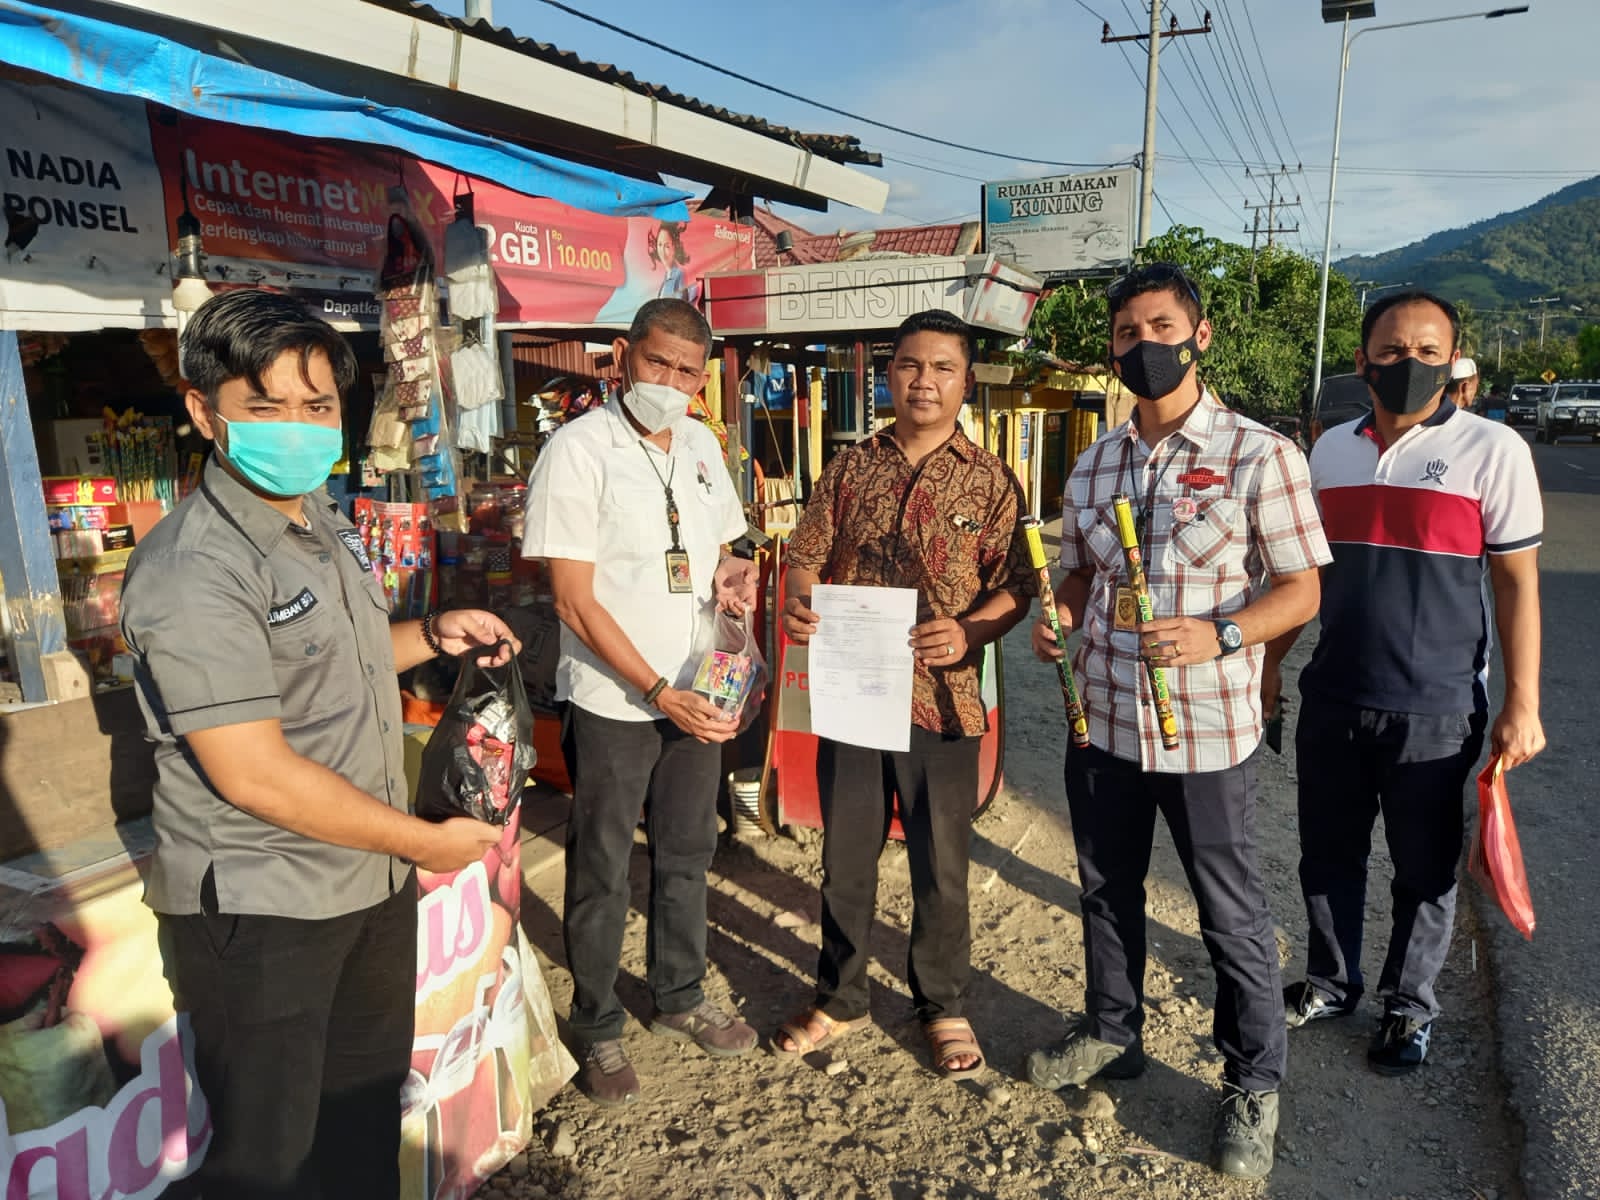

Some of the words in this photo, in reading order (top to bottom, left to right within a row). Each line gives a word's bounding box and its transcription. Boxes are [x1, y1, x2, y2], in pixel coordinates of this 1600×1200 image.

[6, 147, 121, 190] NADIA
[998, 181, 1053, 198] RUMAH
[1059, 175, 1119, 193] MAKAN
[3, 192, 138, 234] PONSEL
[194, 194, 242, 217] Cepat
[244, 203, 272, 221] dan
[274, 203, 322, 228] hemat
[1010, 191, 1103, 218] KUNING
[514, 221, 538, 235] Kuota
[551, 229, 563, 241] Rp
[557, 244, 612, 272] 10.000
[779, 265, 945, 321] BENSIN
[324, 299, 382, 316] Dapatka
